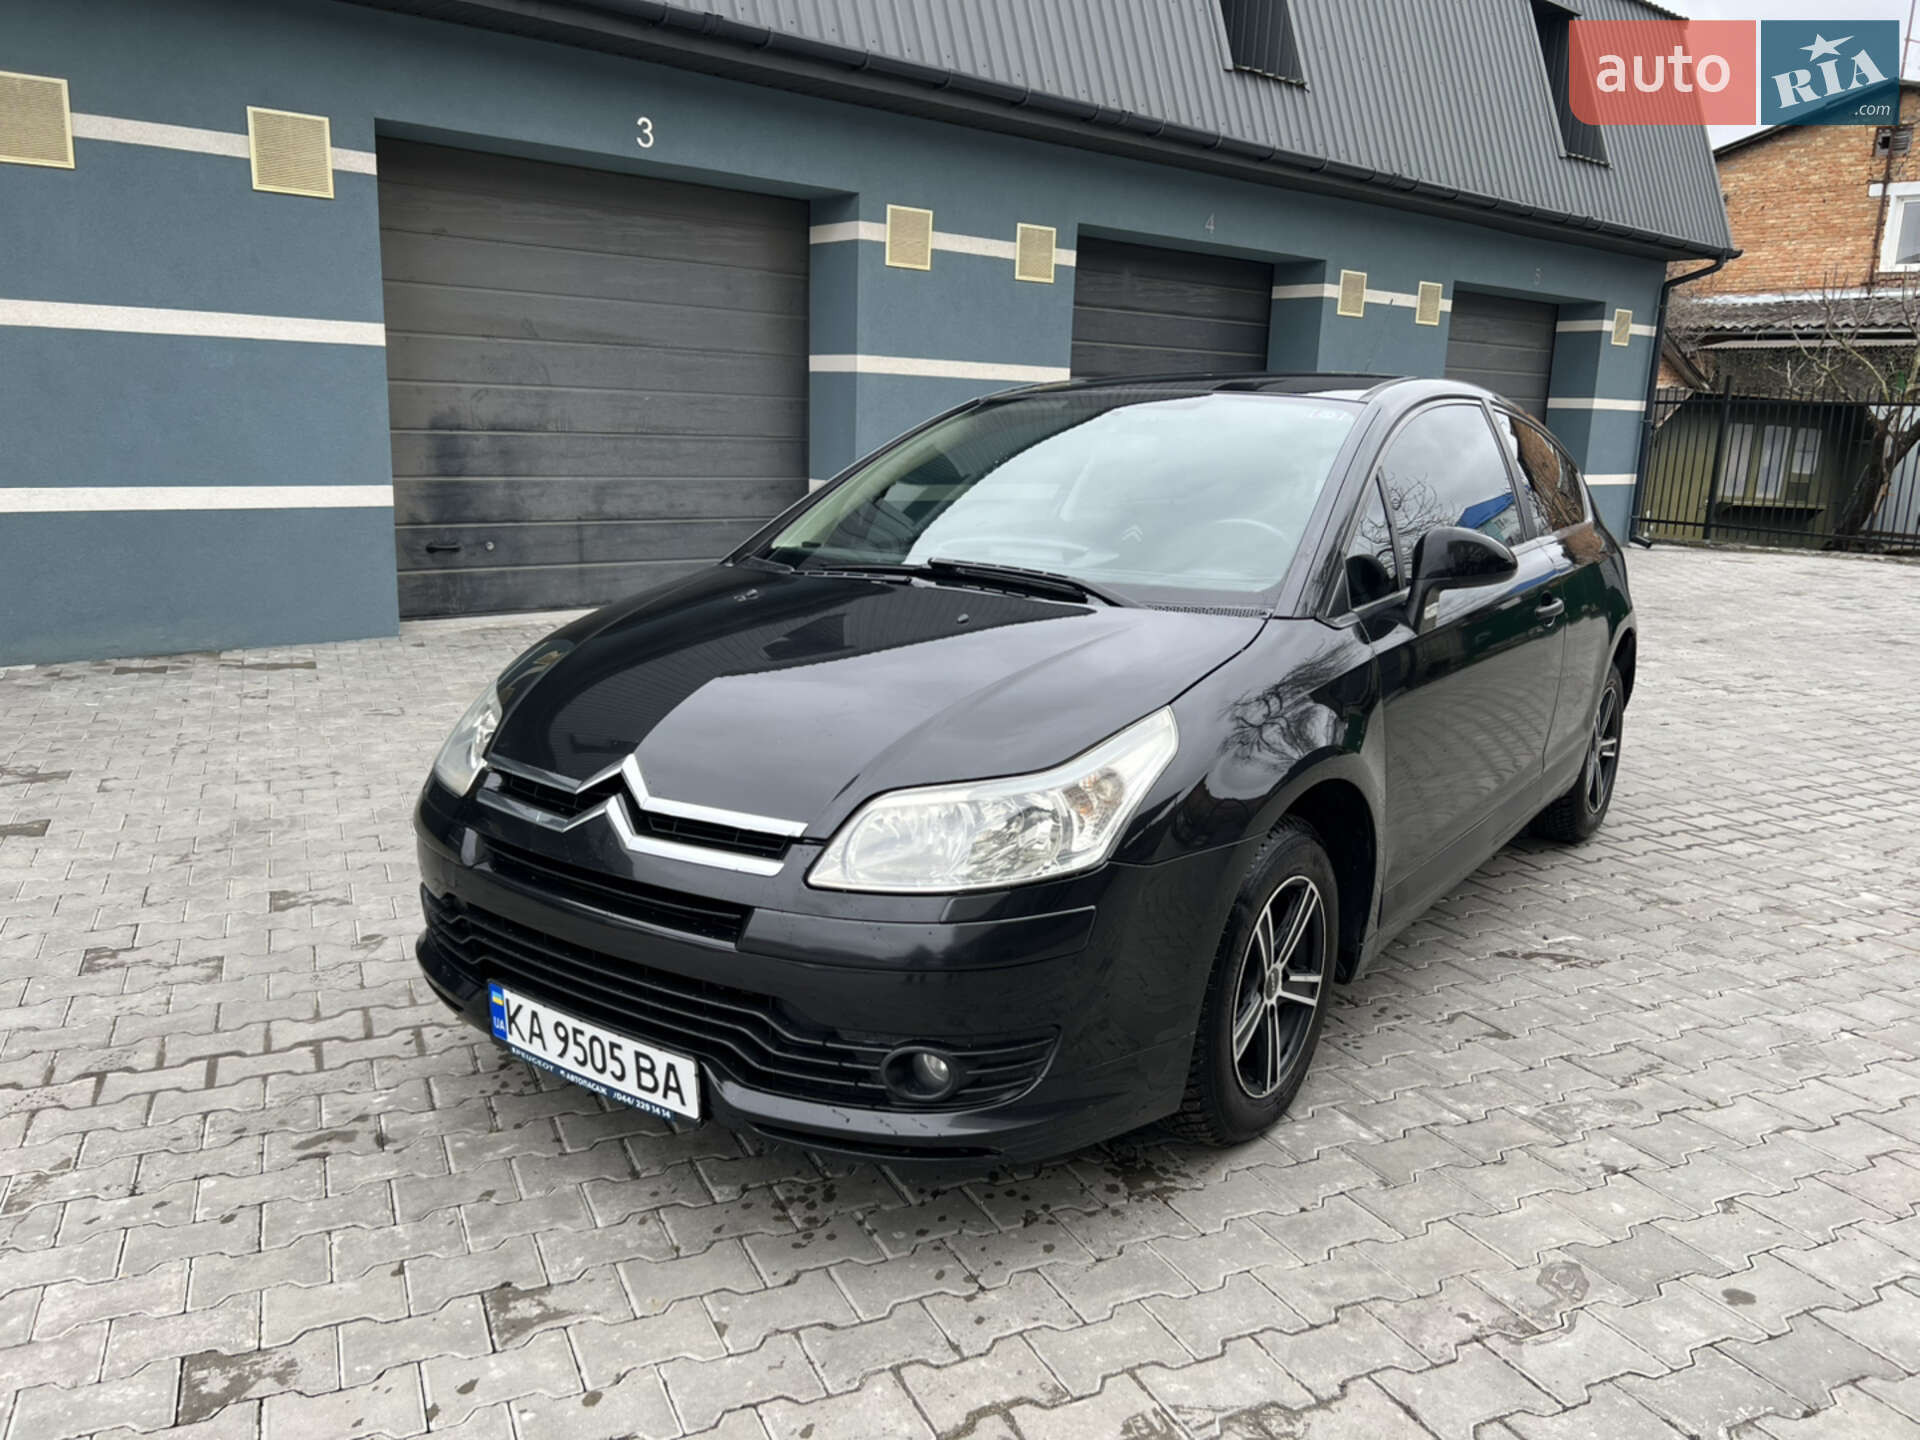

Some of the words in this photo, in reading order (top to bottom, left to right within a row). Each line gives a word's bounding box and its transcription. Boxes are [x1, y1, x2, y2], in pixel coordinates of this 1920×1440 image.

[636, 116, 654, 149] 3
[1205, 212, 1215, 234] 4
[493, 1015, 506, 1032] UA
[505, 997, 548, 1052] KA
[553, 1020, 627, 1083] 9505
[634, 1049, 687, 1107] BA
